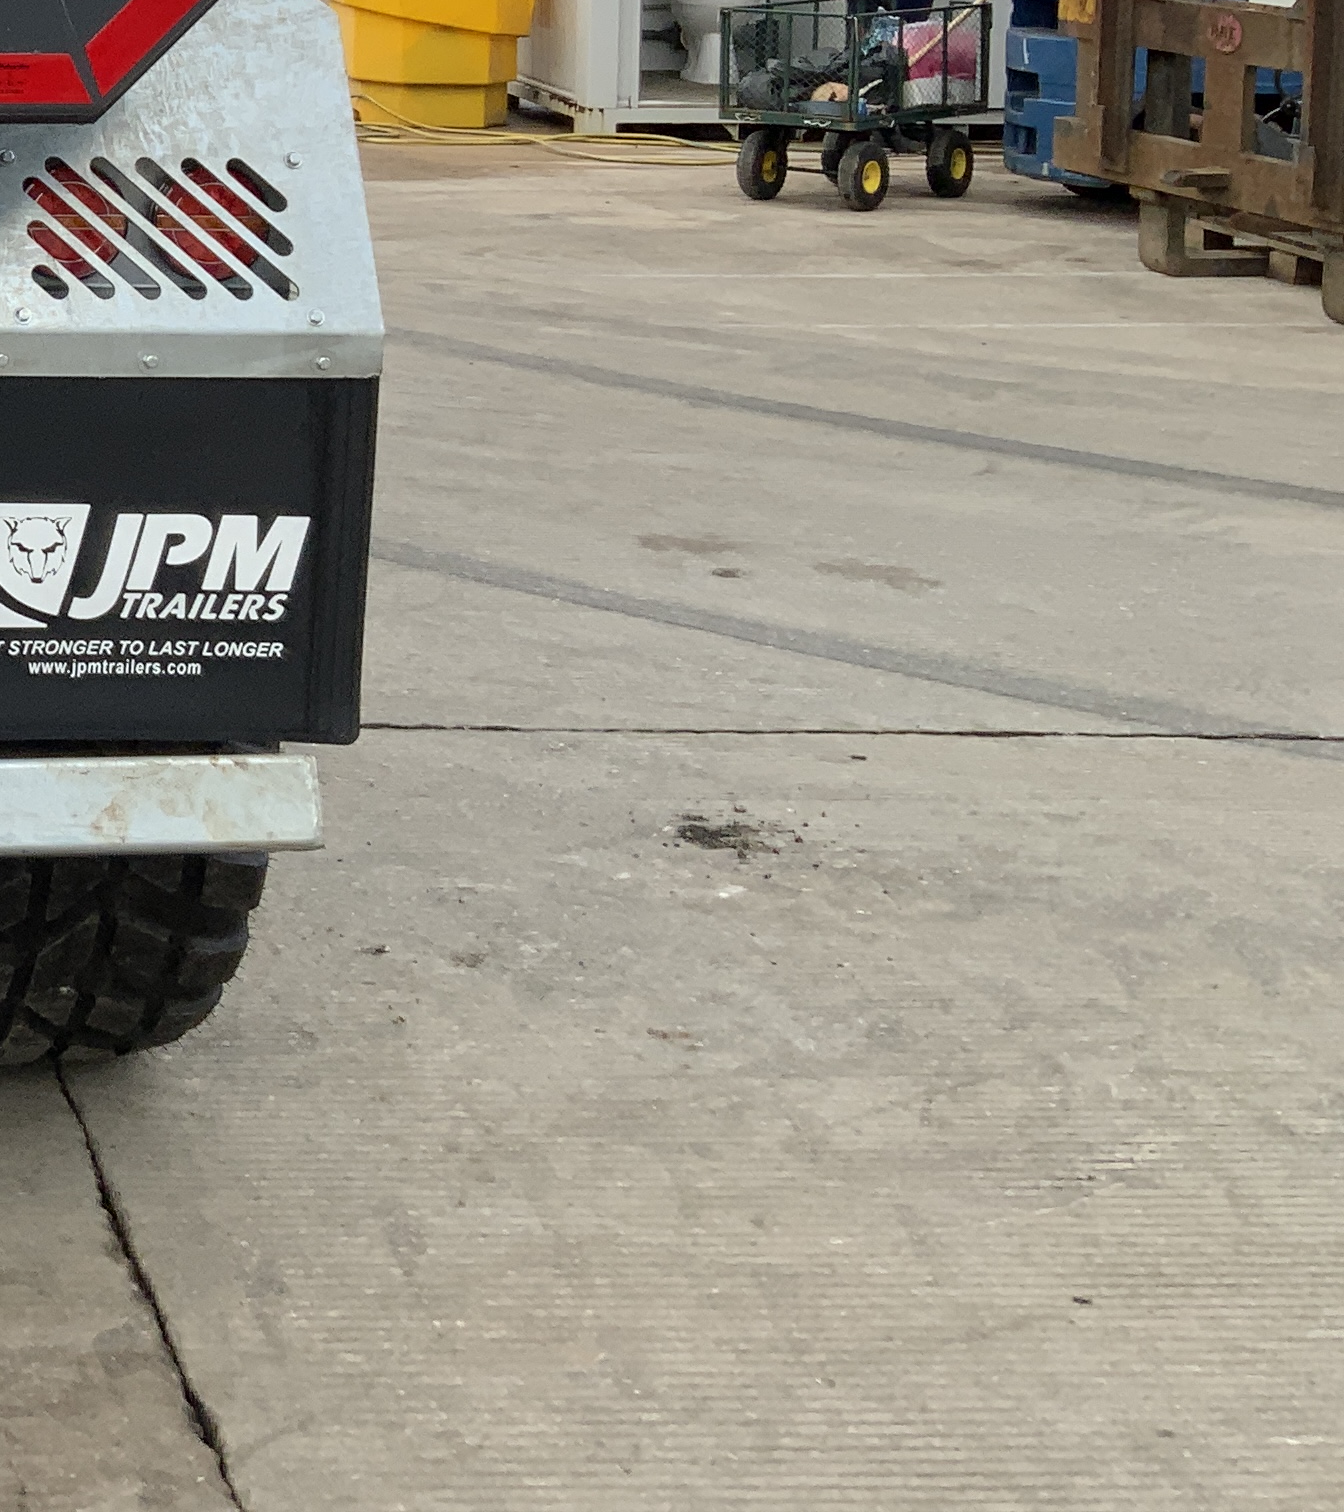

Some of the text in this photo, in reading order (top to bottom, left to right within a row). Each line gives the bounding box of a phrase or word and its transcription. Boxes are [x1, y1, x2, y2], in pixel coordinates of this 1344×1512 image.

[68, 513, 311, 619] JPM
[119, 591, 290, 621] TRAILERS
[8, 640, 114, 656] STRONGER
[119, 640, 145, 656] TO
[148, 640, 200, 657] LAST
[202, 641, 284, 658] LONGER
[28, 658, 202, 678] www.jpmtrailers.com
